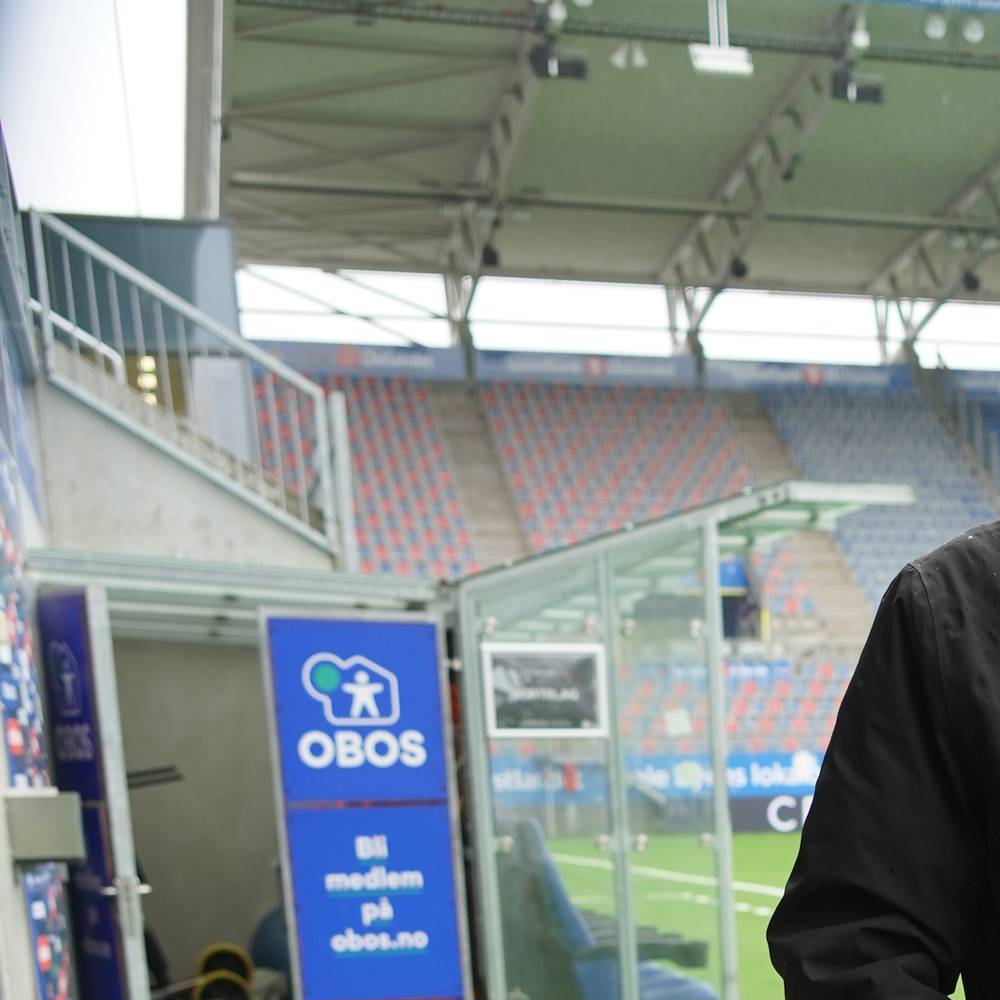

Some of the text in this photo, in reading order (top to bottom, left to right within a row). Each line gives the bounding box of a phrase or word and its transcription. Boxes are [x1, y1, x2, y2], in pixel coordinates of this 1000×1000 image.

[298, 730, 427, 769] OBOS
[354, 835, 389, 860] Bli
[325, 866, 424, 892] medlem
[361, 897, 394, 927] på
[330, 927, 429, 953] obos.no
